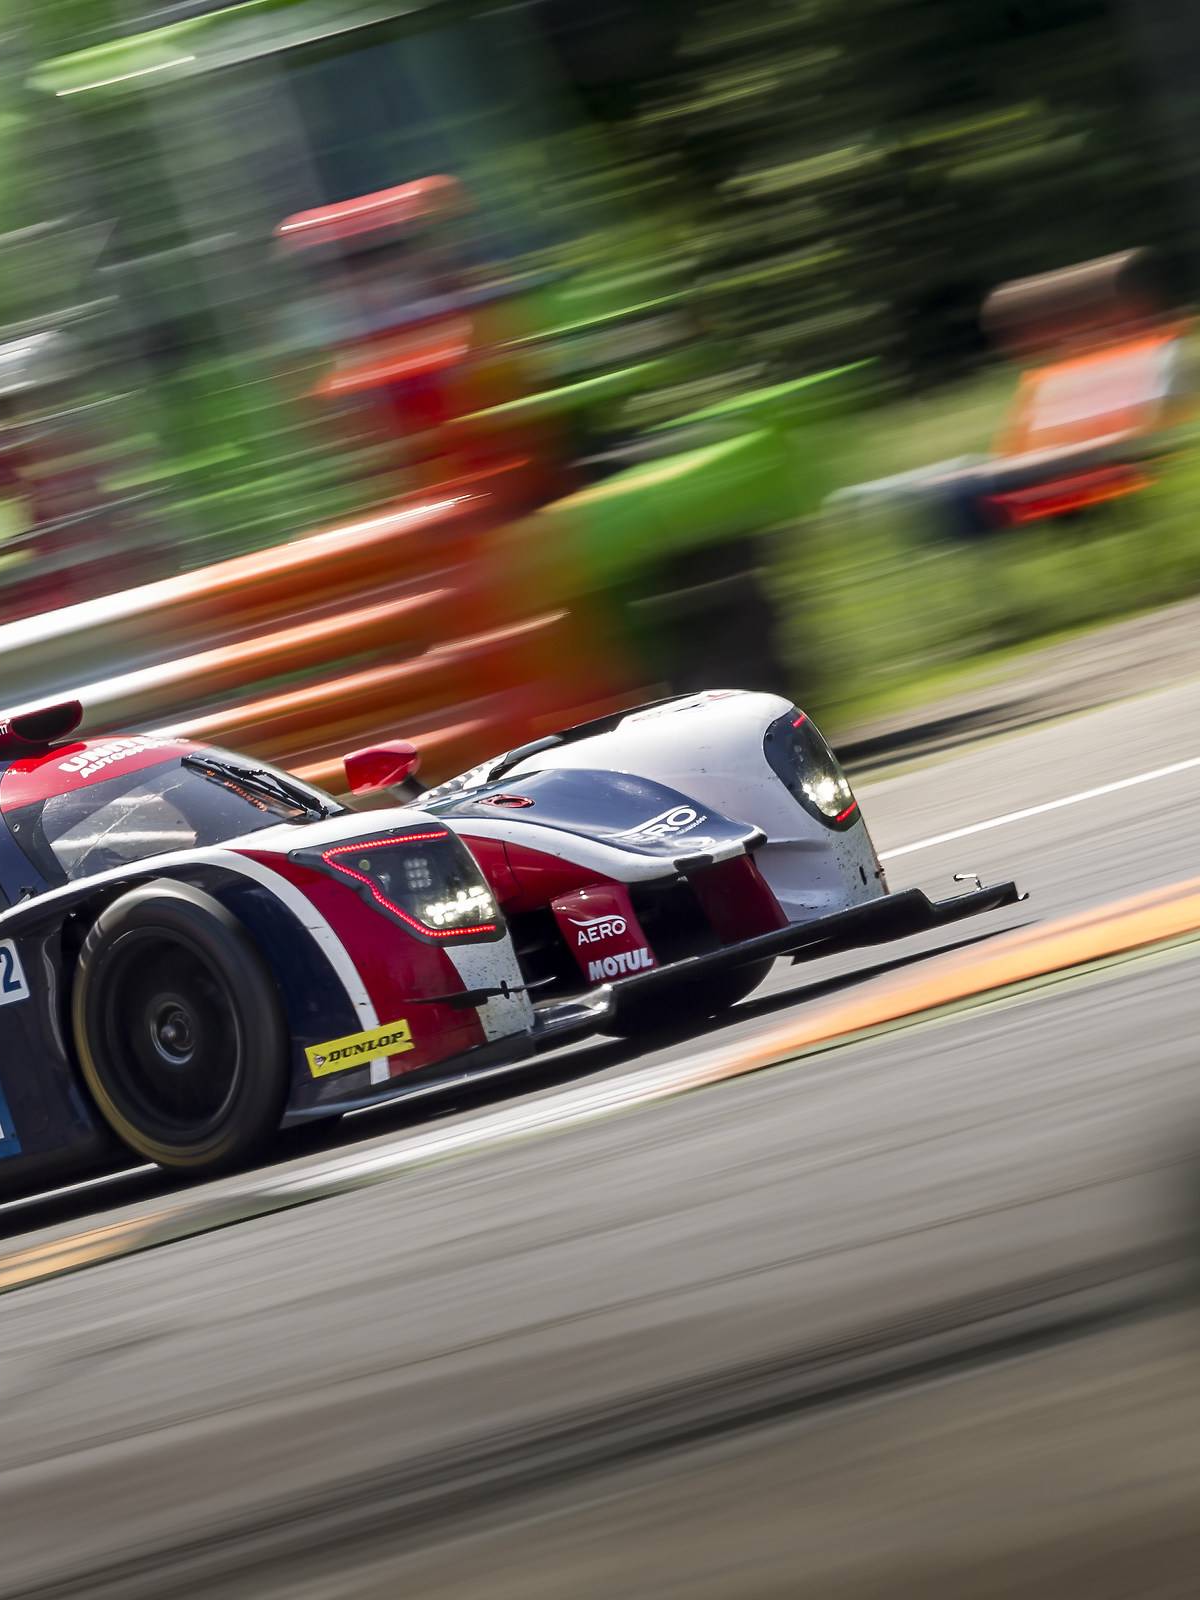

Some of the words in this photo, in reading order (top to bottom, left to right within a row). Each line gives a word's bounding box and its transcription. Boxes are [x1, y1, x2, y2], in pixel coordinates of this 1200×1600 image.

[577, 919, 627, 946] AERO
[588, 947, 654, 982] MOTUL
[328, 1031, 404, 1062] DUNLOP
